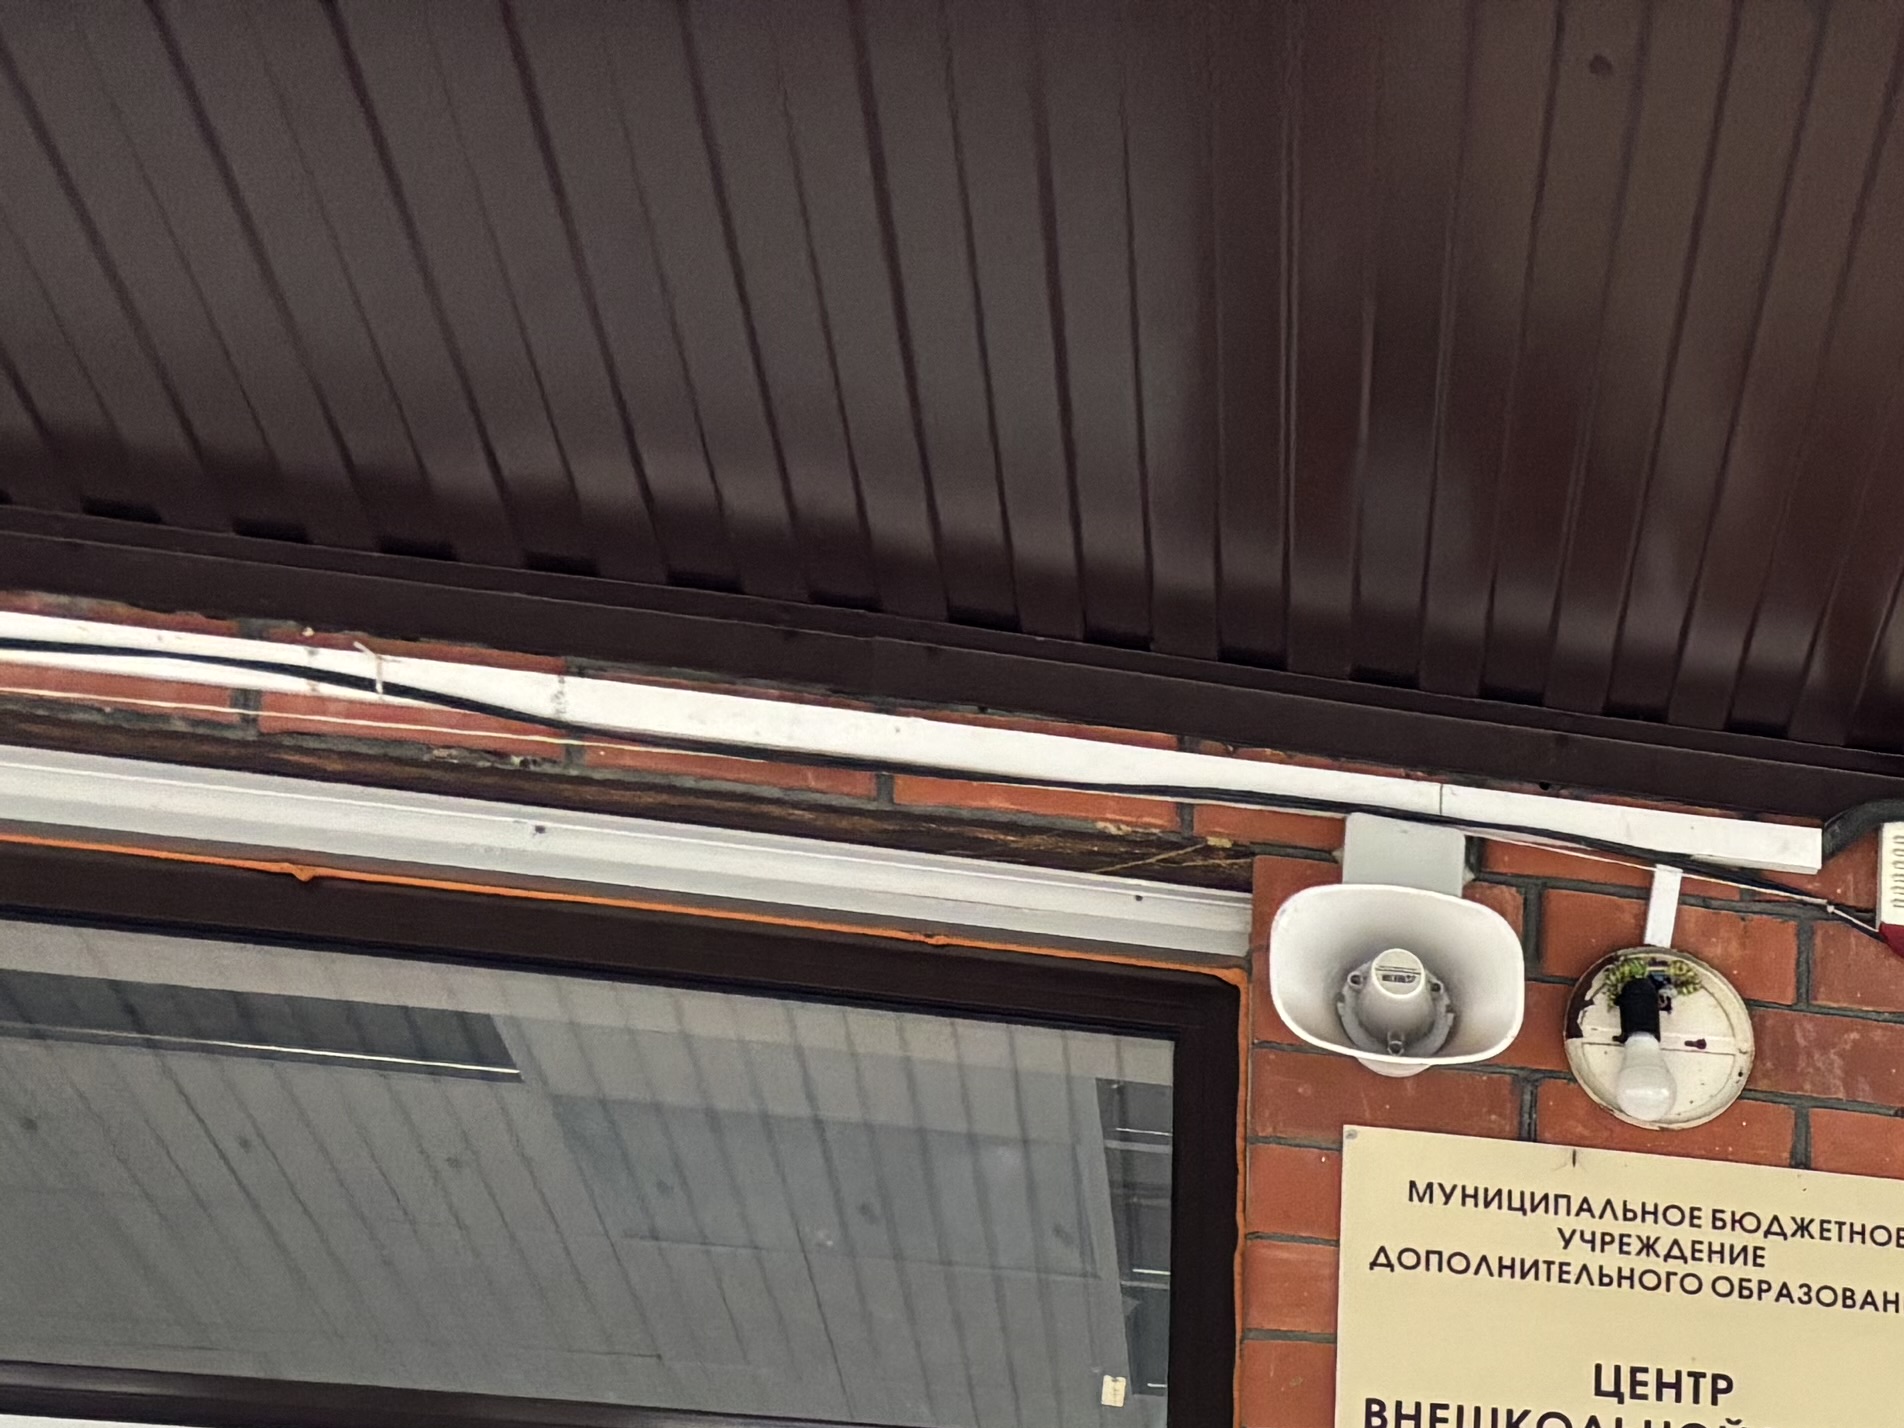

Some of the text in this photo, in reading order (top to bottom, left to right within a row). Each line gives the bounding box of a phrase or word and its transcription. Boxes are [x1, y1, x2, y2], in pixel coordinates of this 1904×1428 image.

[1408, 1180, 1703, 1230] МУНИЦИПАЛЬНОЕ
[1369, 1245, 1703, 1295] ДОПОЛНИТЕЛЬНОГО
[1556, 1227, 1766, 1268] УЧРЕЖДЕНИЕ
[1593, 1362, 1734, 1406] ЦЕНТР
